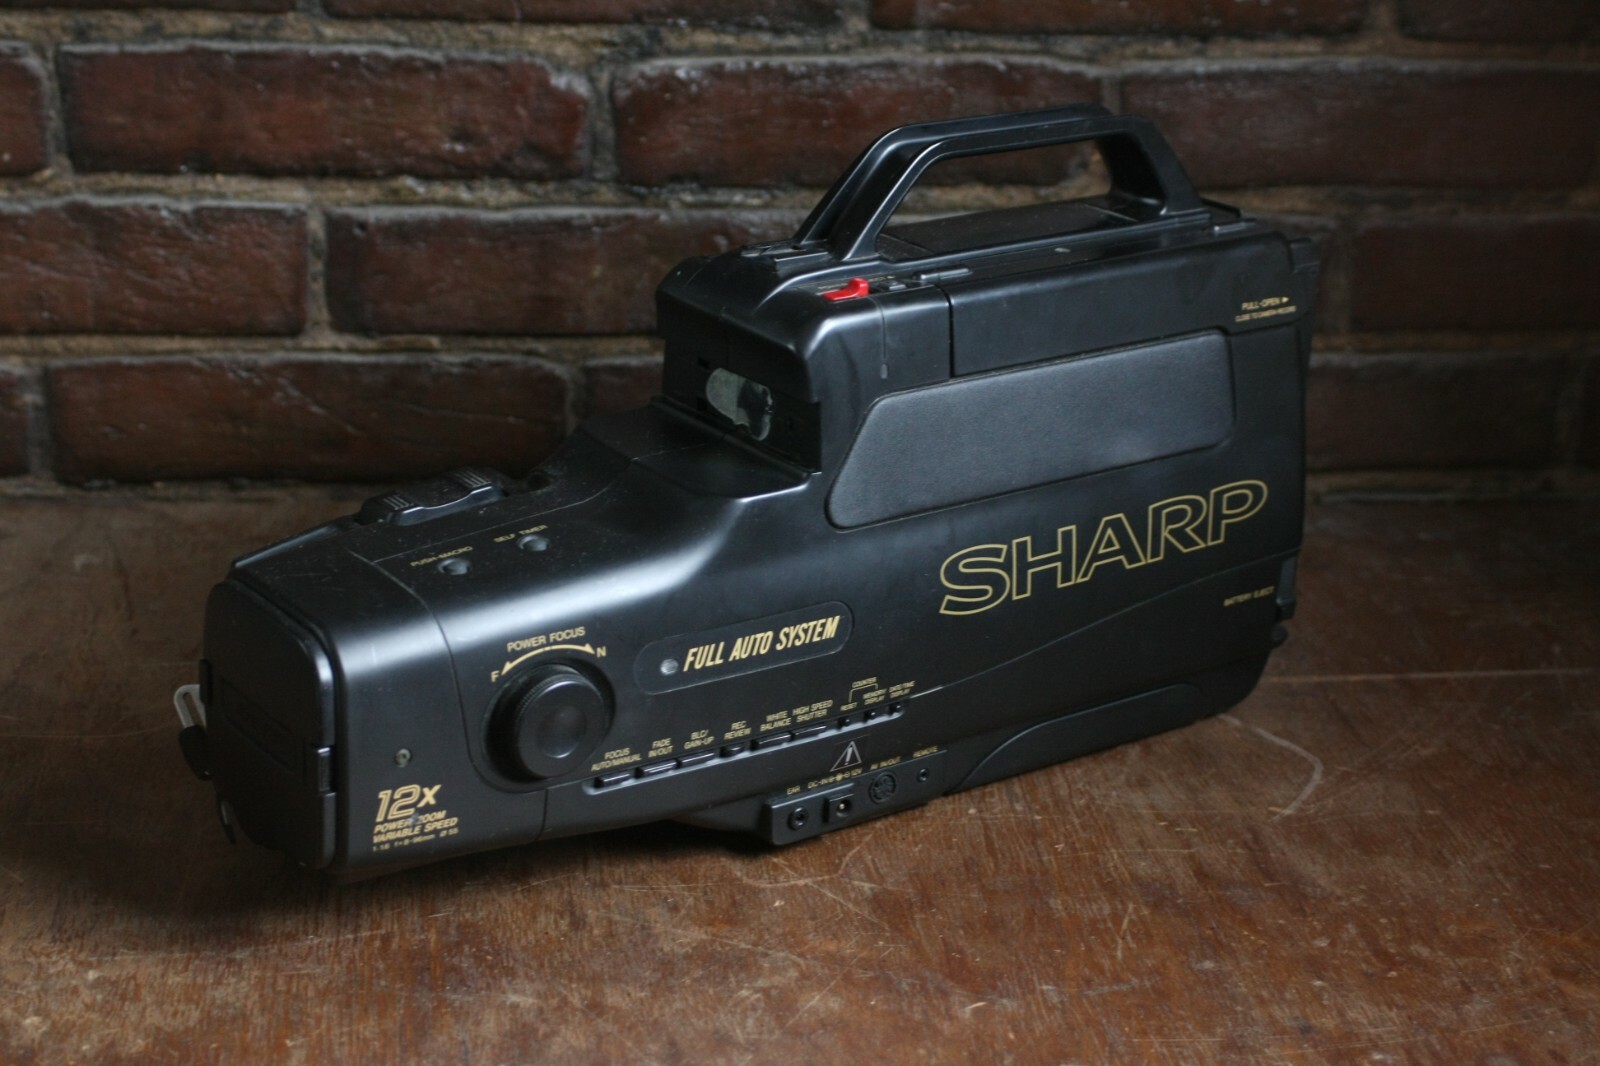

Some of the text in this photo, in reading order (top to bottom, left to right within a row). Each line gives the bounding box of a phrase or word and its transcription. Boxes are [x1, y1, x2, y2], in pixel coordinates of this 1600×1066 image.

[939, 479, 1268, 615] SHARP
[507, 626, 586, 652] POWER FOCUS
[683, 615, 841, 672] FULL AUTO SYSTEM
[596, 646, 607, 658] N
[491, 670, 500, 682] F
[792, 699, 833, 716] HIGH SPEED
[766, 710, 788, 722] WHITE
[796, 709, 827, 722] SHUTTER
[731, 720, 747, 730] REC
[760, 717, 791, 731] BALANCE
[724, 727, 752, 740] REVIEW
[652, 738, 671, 749] FADE
[683, 736, 714, 749] GAIN-UP
[604, 748, 630, 760] FOCUS
[372, 817, 459, 843] VARIABLE SPEED
[373, 818, 412, 834] POWER
